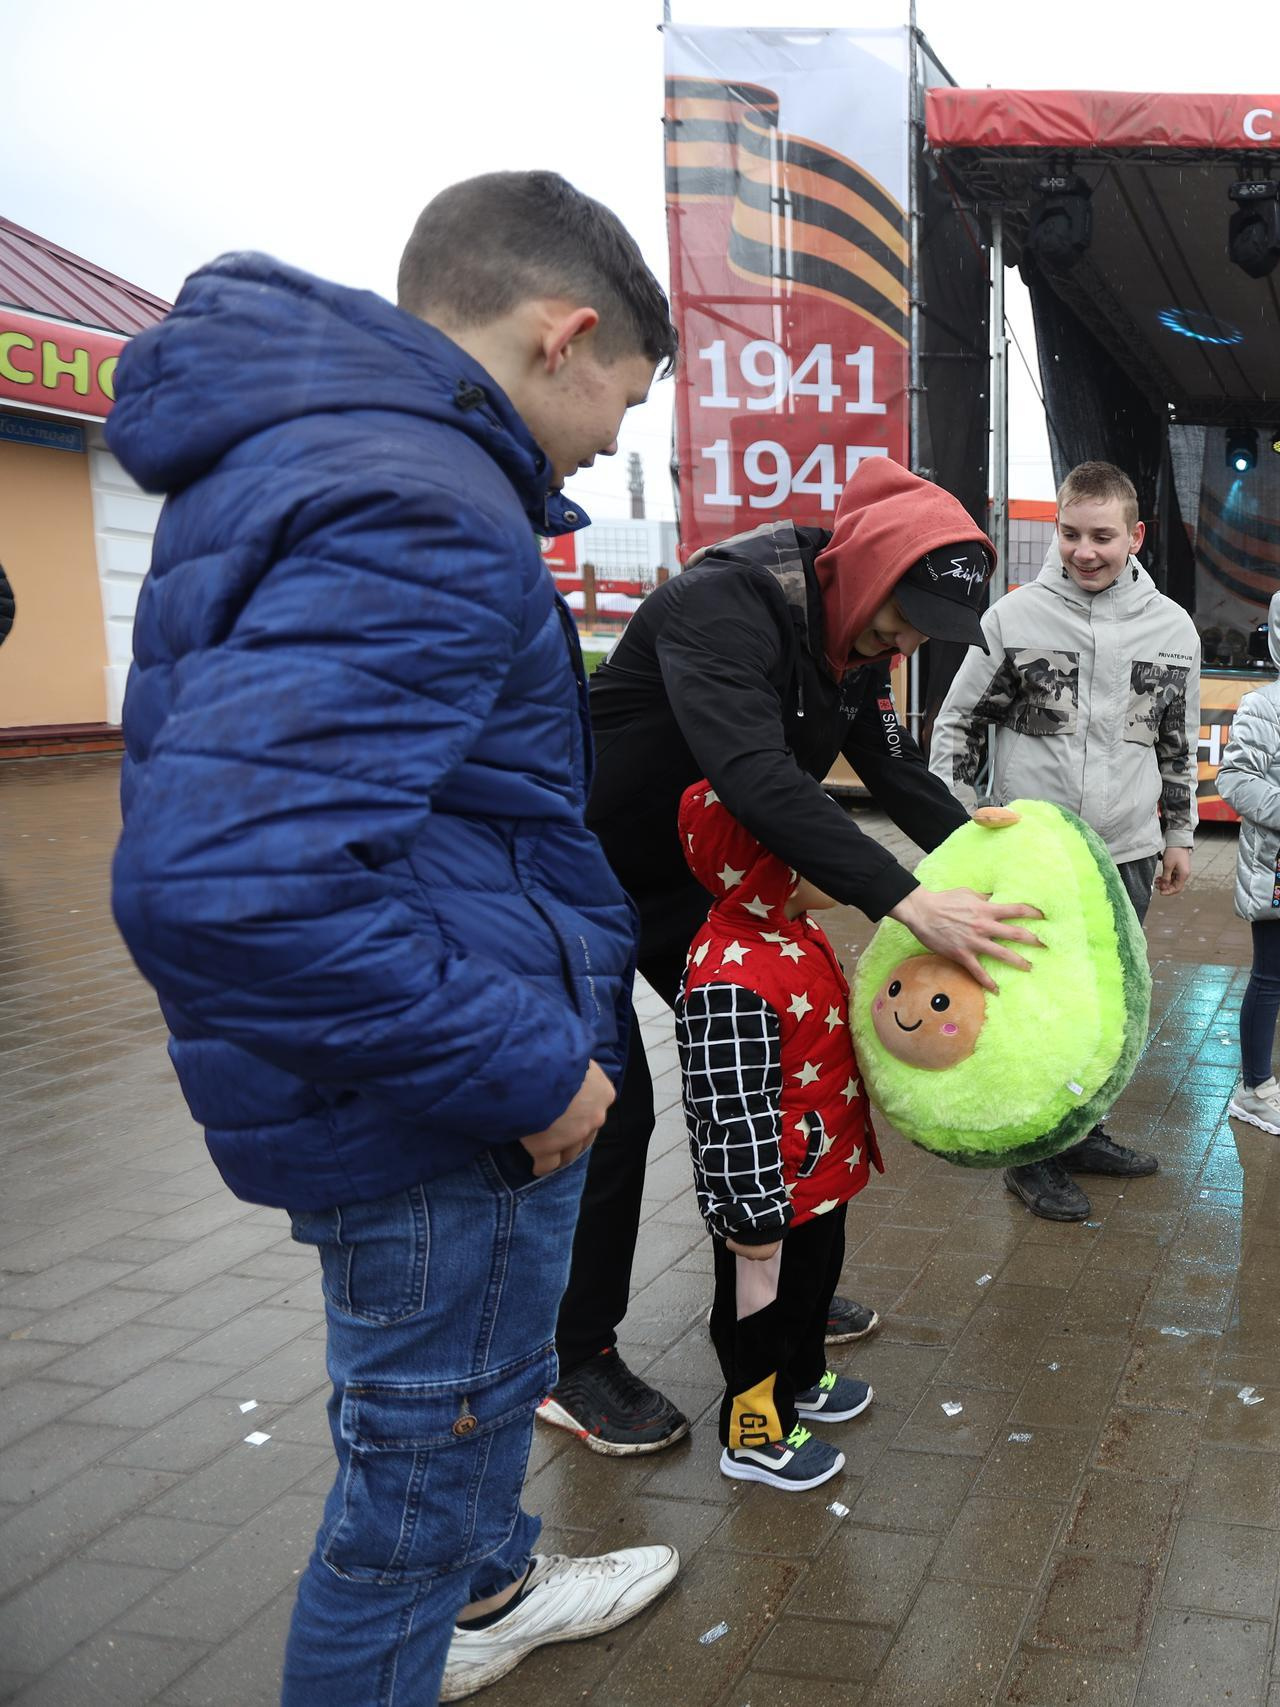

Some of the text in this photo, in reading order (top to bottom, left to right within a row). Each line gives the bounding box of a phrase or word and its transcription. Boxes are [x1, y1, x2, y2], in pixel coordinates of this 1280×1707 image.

[1242, 107, 1273, 142] С
[699, 340, 887, 414] 1941
[882, 713, 903, 759] SNOW
